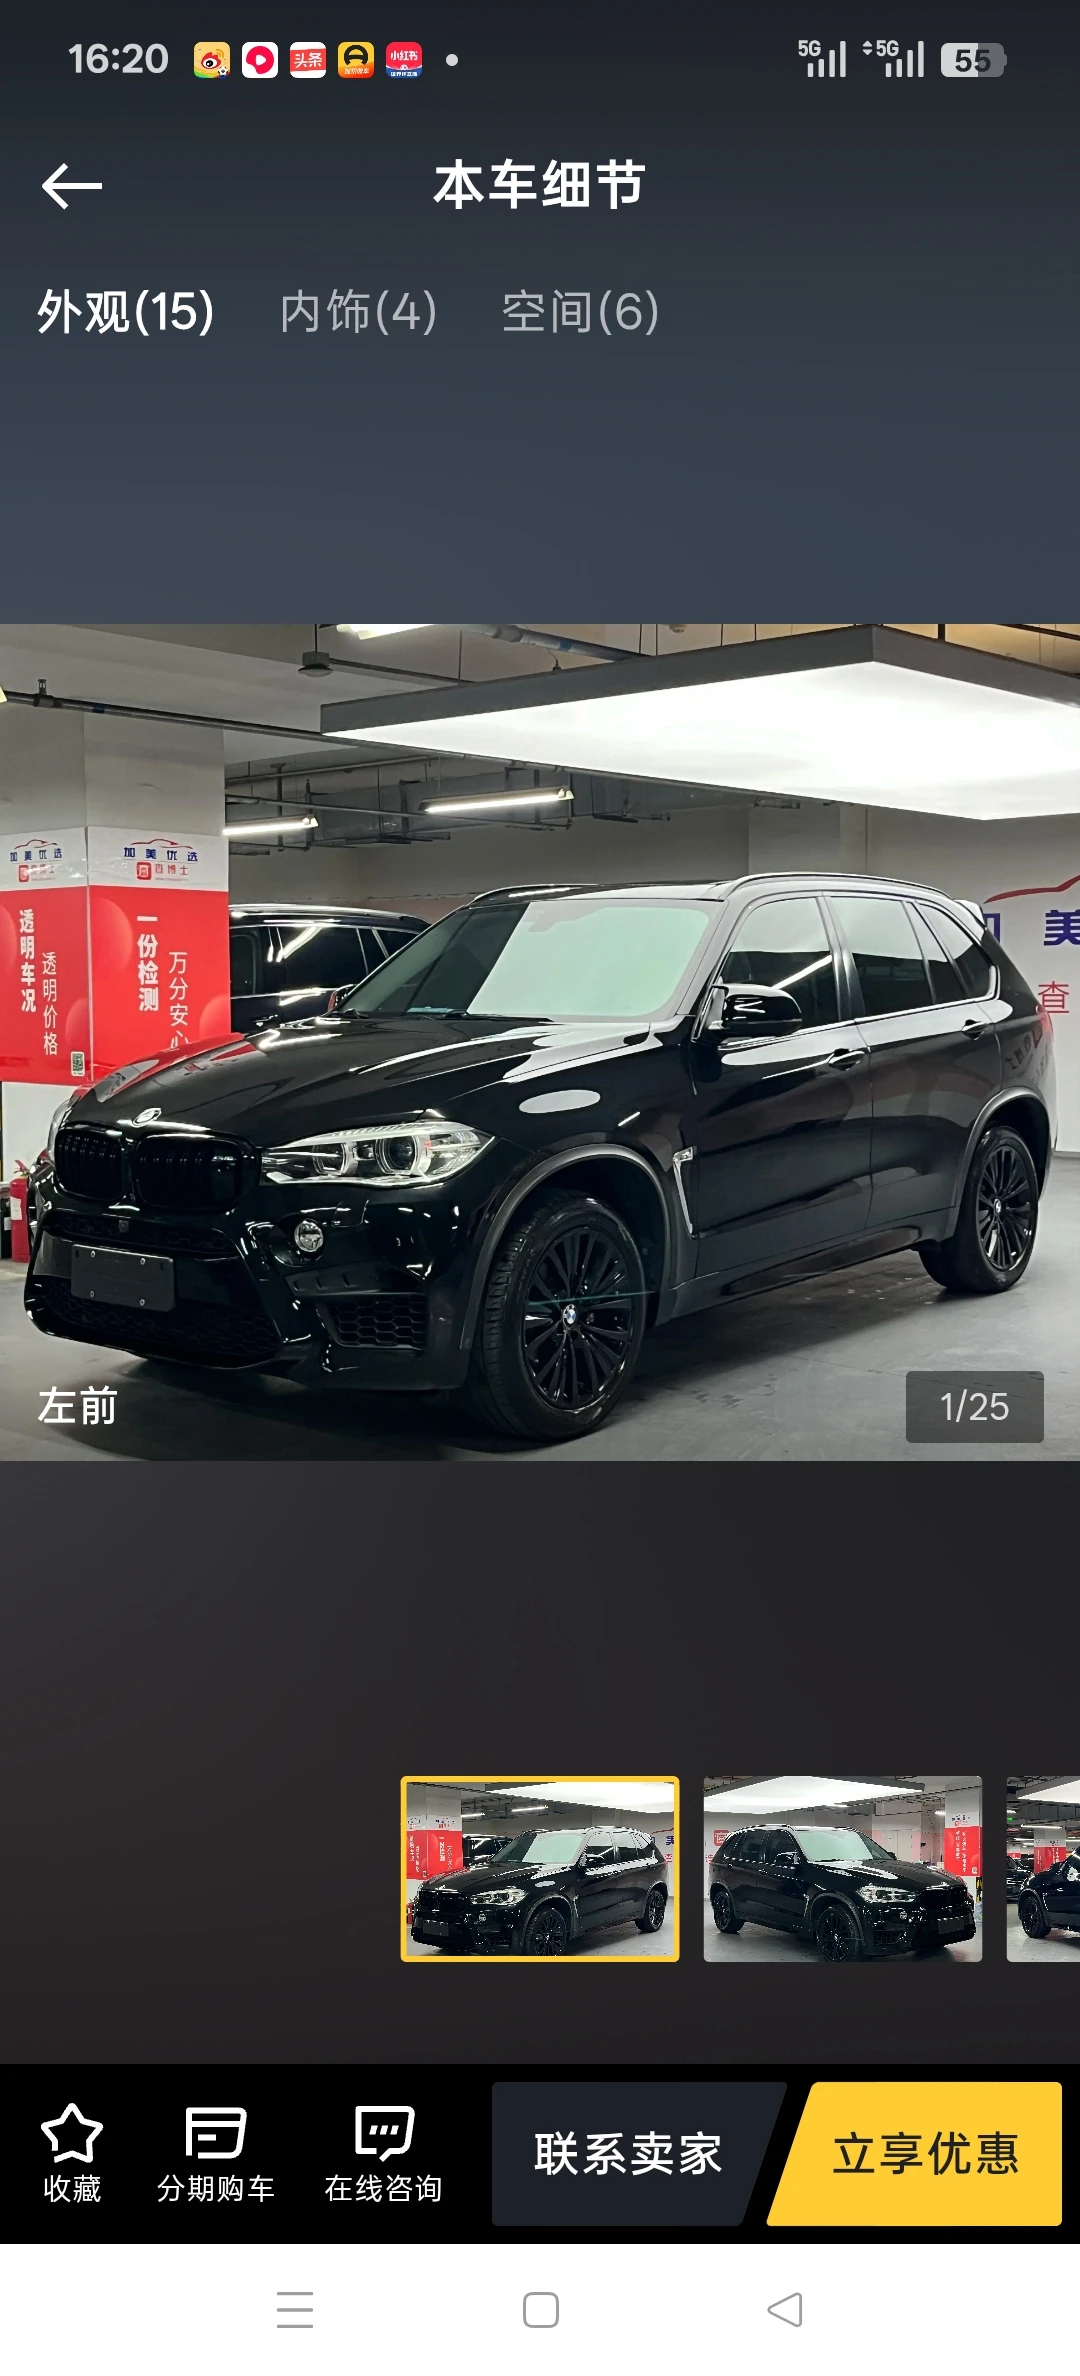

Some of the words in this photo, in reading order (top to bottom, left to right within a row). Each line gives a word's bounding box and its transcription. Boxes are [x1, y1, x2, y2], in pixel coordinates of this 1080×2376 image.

[69, 44, 168, 73] 16:20
[294, 52, 323, 68] 头条
[390, 50, 418, 62] 小红书
[799, 40, 821, 56] 5G
[877, 40, 899, 56] 5G
[954, 49, 992, 73] 55
[433, 158, 645, 209] 本车细节
[37, 289, 212, 336] 外观(15)
[282, 289, 435, 335] 内饰(4)
[502, 289, 657, 335] 空间(6)
[10, 847, 63, 862] 加美优选
[124, 847, 198, 862] 加美优选
[19, 908, 37, 1013] 透明车况
[136, 915, 159, 1012] 一份检测
[41, 952, 58, 1056] 透明价格
[168, 951, 189, 1050] 万分安心
[1038, 981, 1069, 1014] 查
[534, 2131, 723, 2175] 联系卖家
[833, 2131, 1019, 2175] 立享优惠
[43, 2174, 101, 2203] 收藏
[157, 2174, 275, 2203] 分期购车
[324, 2174, 442, 2203] 在线咨询
